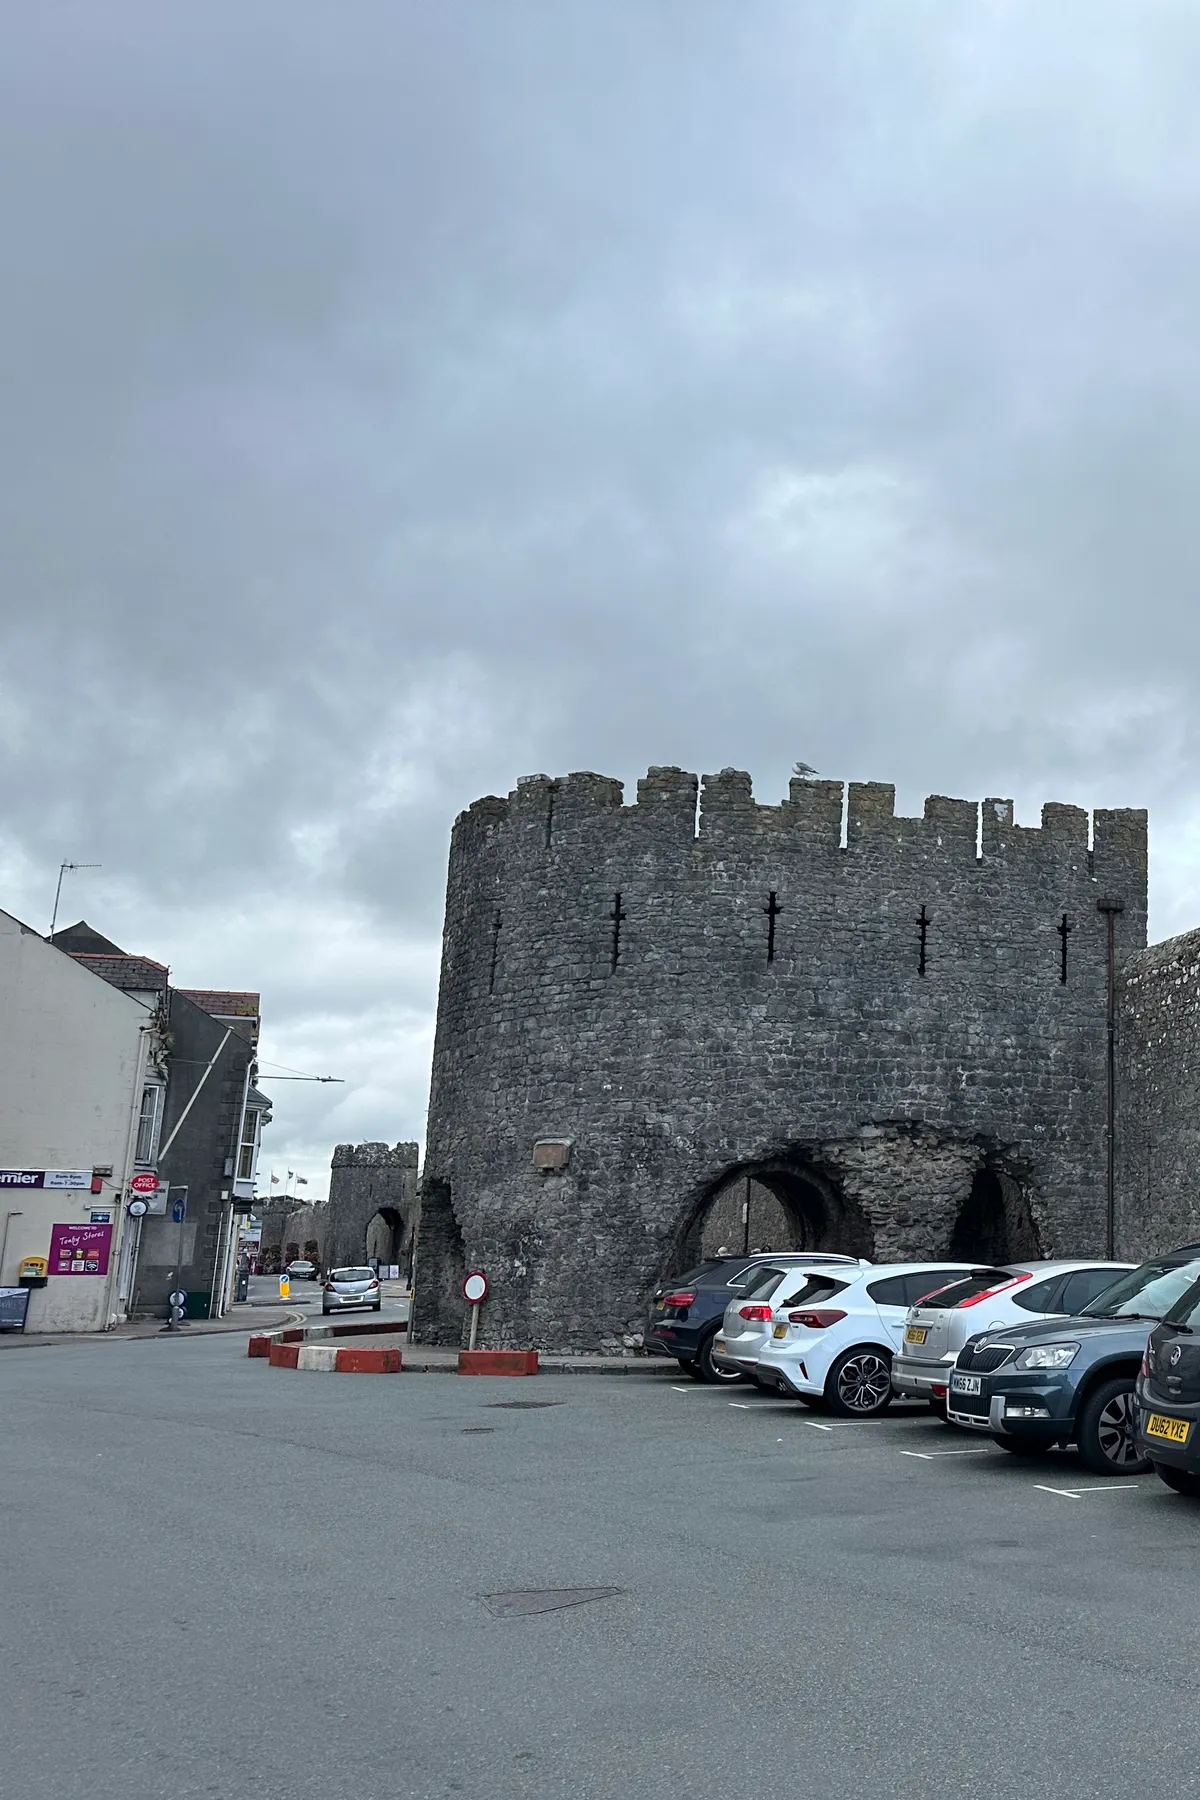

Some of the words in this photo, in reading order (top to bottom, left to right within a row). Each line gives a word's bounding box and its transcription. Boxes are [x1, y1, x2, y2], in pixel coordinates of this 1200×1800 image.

[0, 1172, 38, 1184] mier
[59, 1235, 80, 1246] Tenby
[82, 1231, 104, 1241] Stores
[1150, 1416, 1171, 1435] DU62
[1171, 1421, 1186, 1439] YXE
